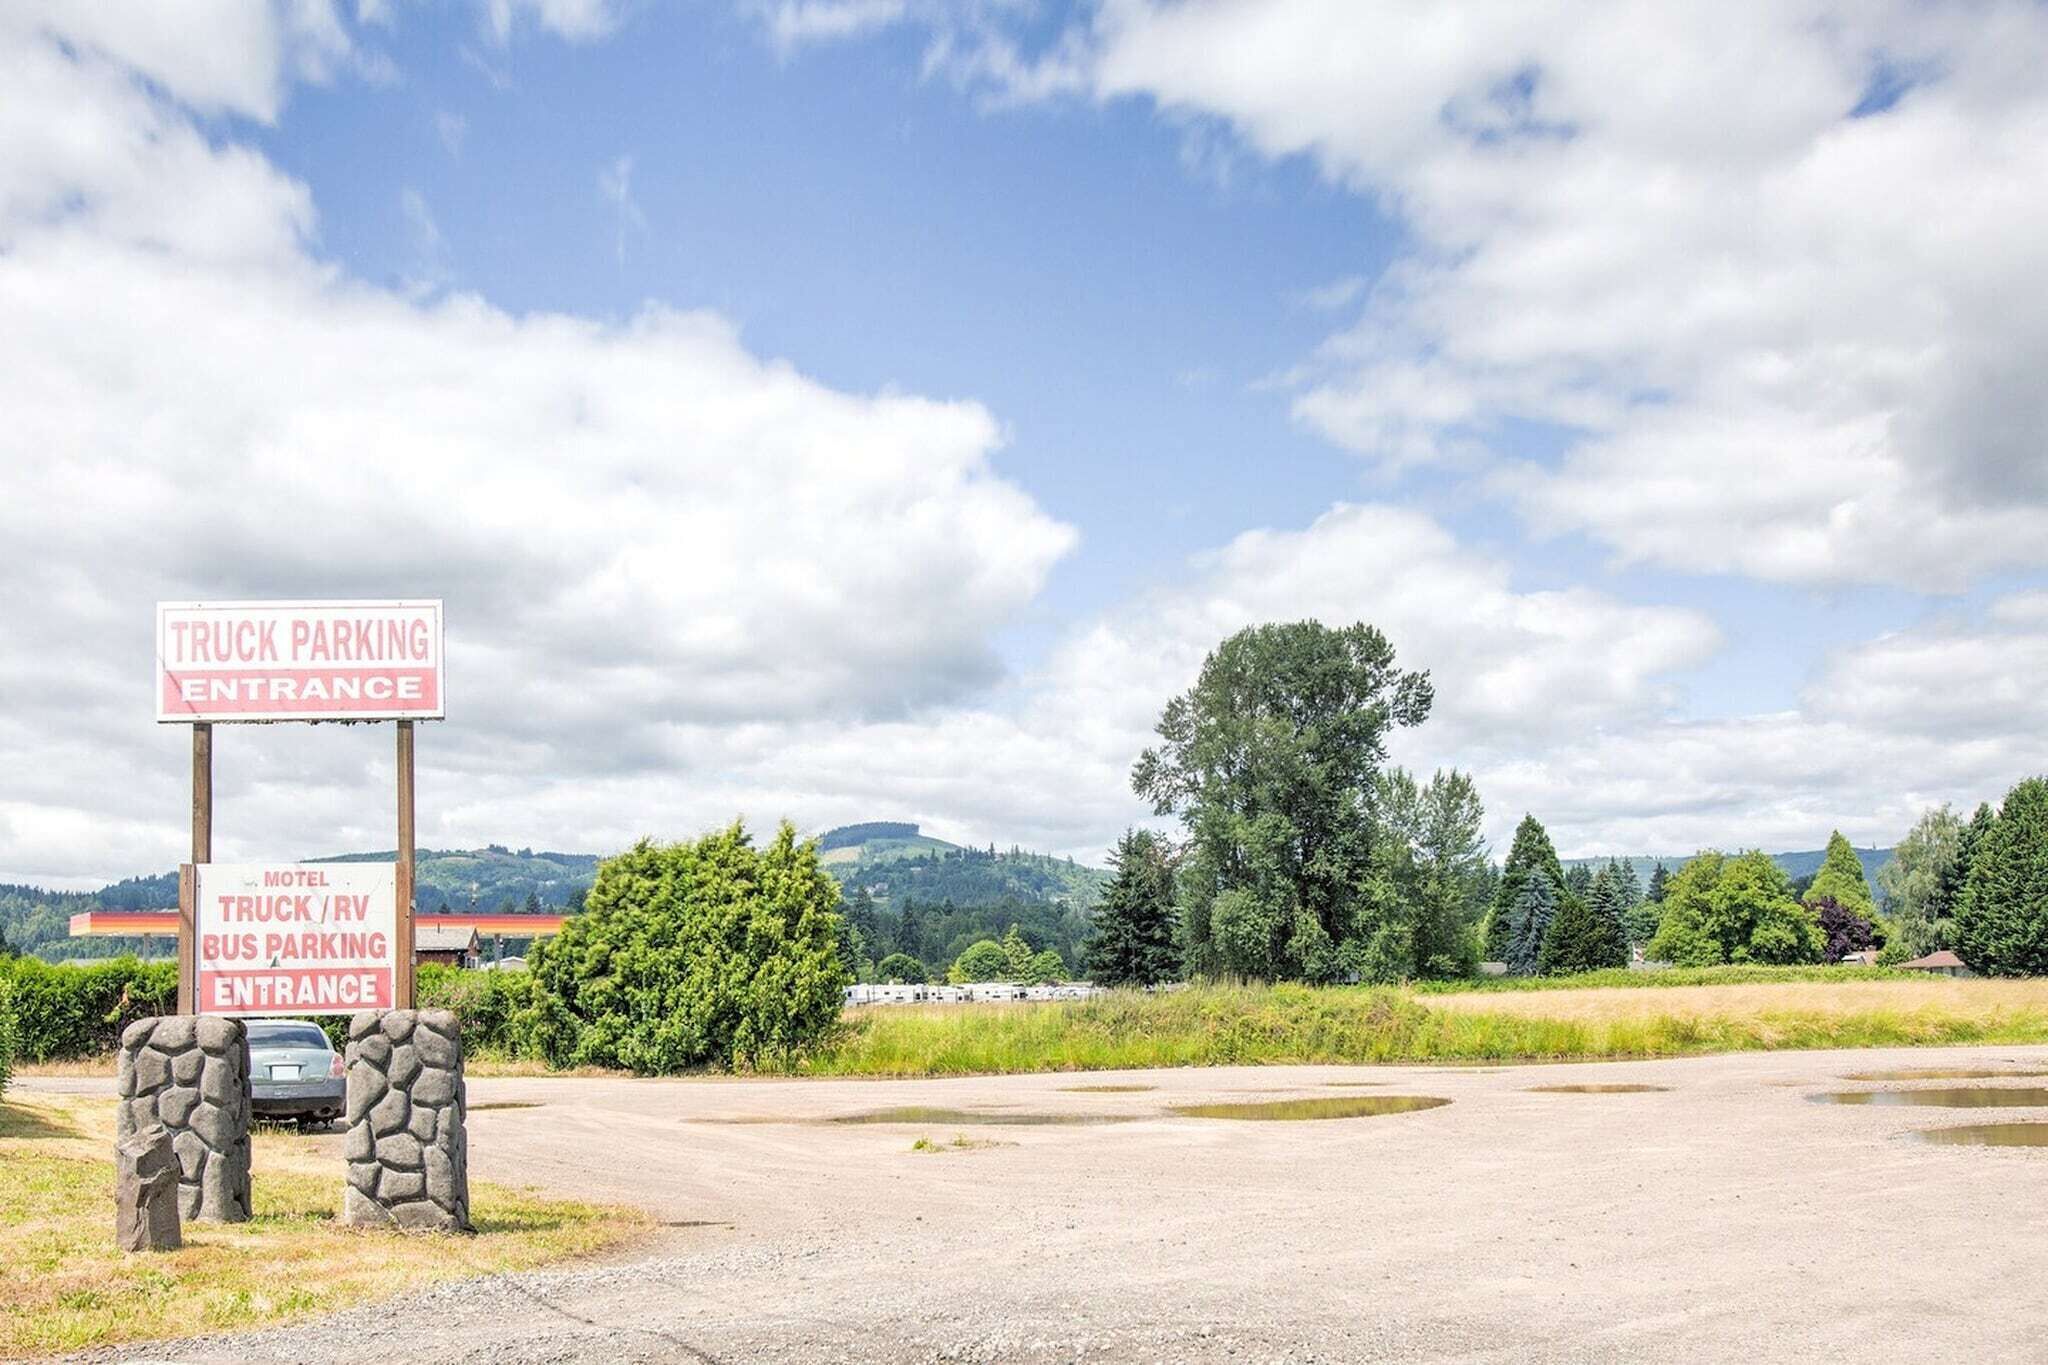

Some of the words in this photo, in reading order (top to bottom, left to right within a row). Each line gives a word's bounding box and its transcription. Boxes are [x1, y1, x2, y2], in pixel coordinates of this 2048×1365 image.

[171, 620, 278, 662] TRUCK
[291, 618, 429, 662] PARKING
[180, 676, 422, 701] ENTRANCE
[264, 871, 330, 887] MOTEL
[218, 895, 312, 922] TRUCK
[203, 933, 258, 961] BUS
[265, 932, 387, 960] PARKING
[214, 973, 378, 1007] ENTRANCE
